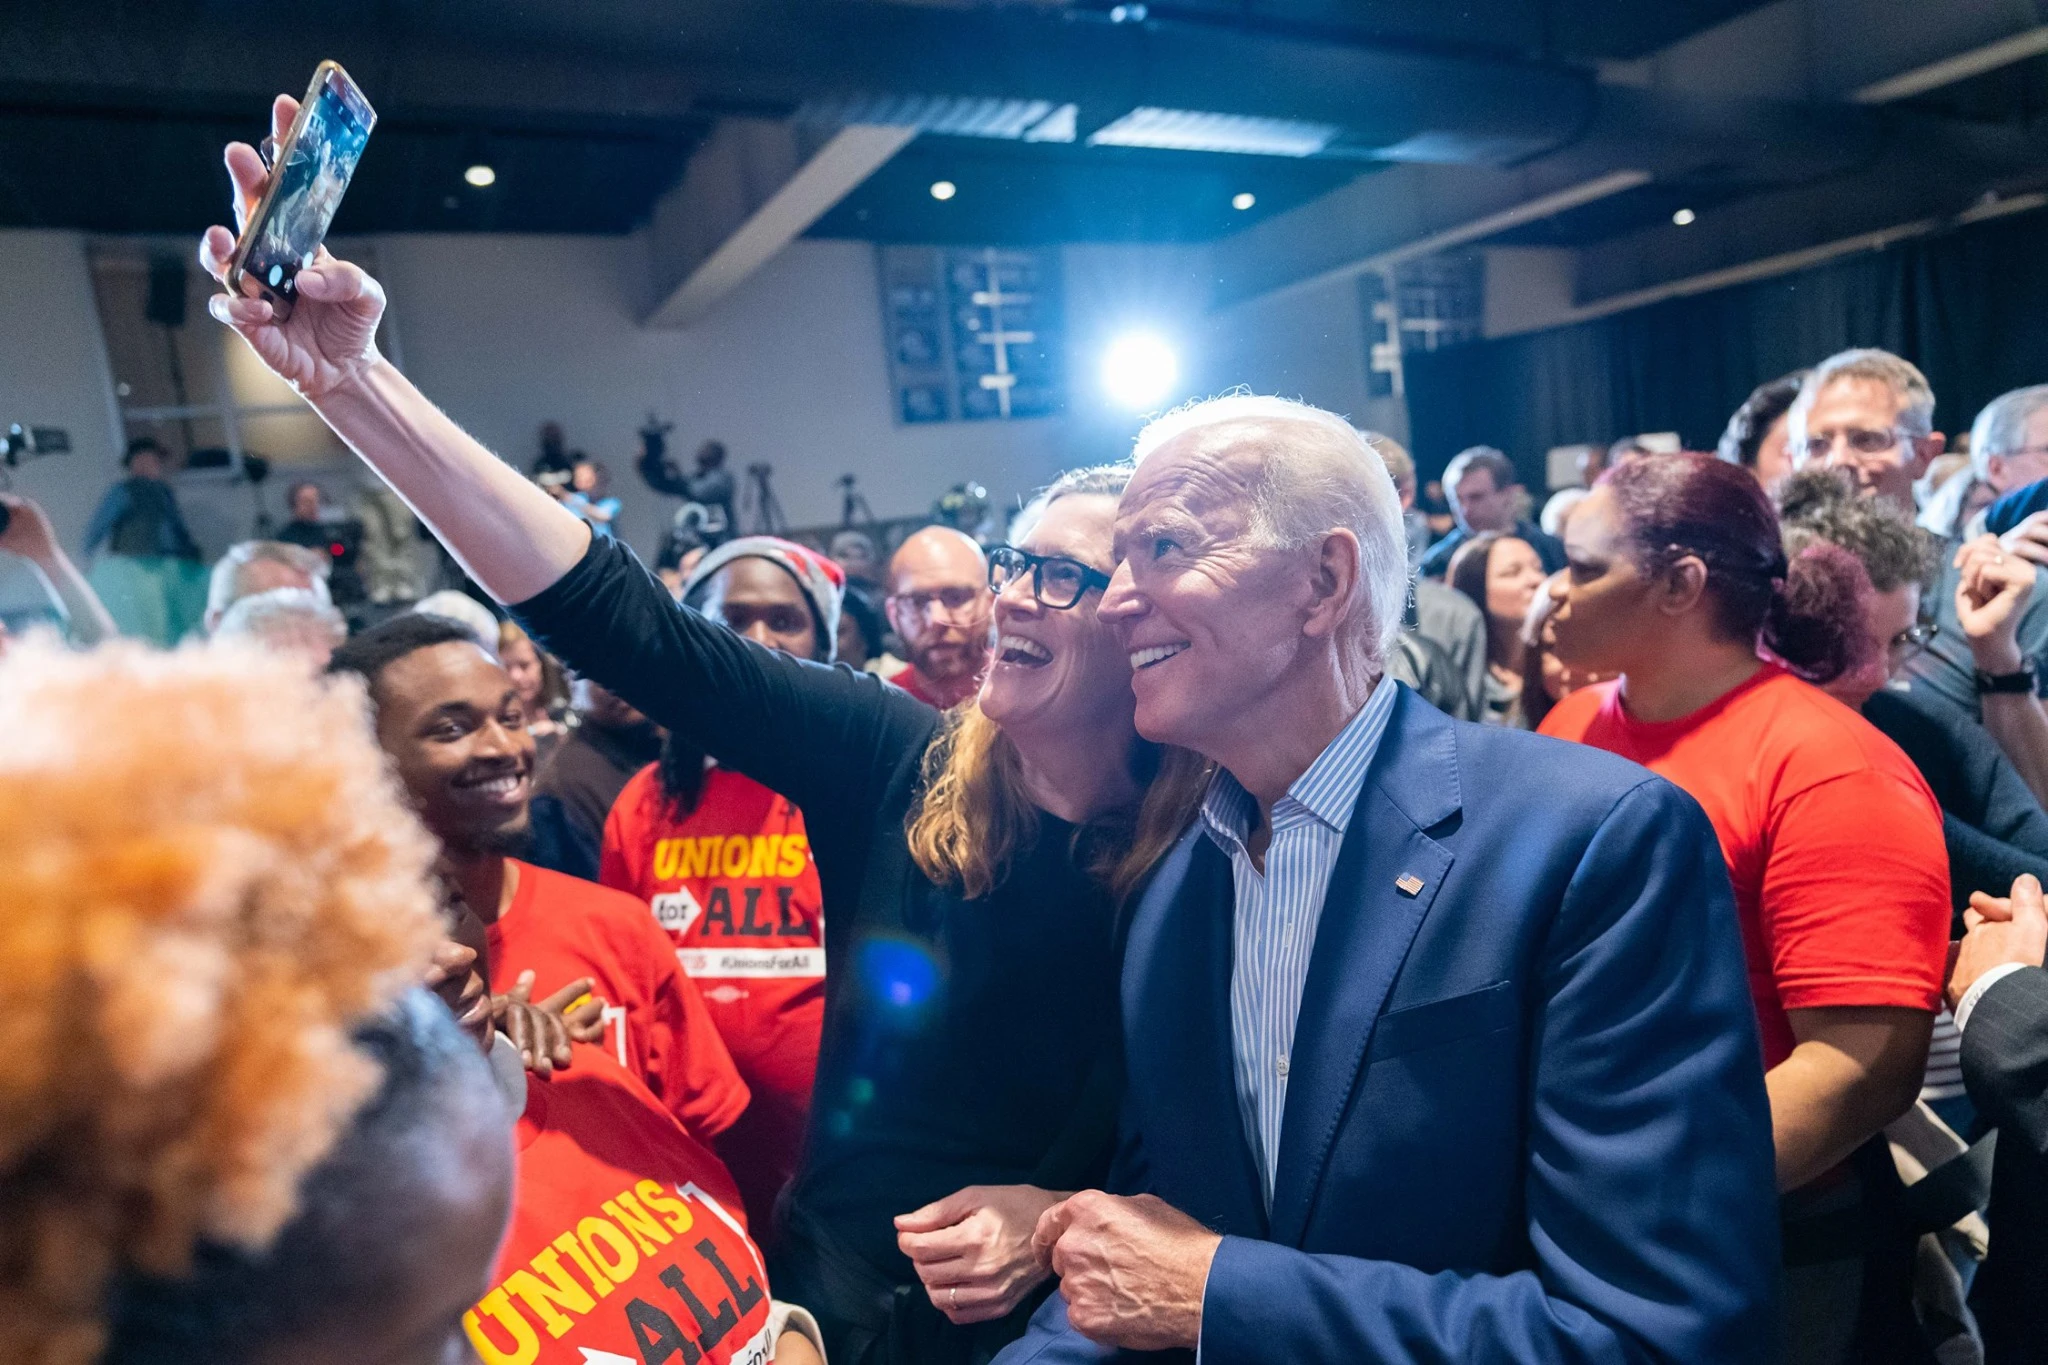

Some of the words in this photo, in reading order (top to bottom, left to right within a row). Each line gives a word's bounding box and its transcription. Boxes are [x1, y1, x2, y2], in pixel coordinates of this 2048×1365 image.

[655, 834, 805, 879] UNIONS
[658, 902, 688, 922] for
[702, 887, 811, 936] ALL
[463, 1179, 694, 1365] UNIONS
[625, 1238, 764, 1365] ALL
